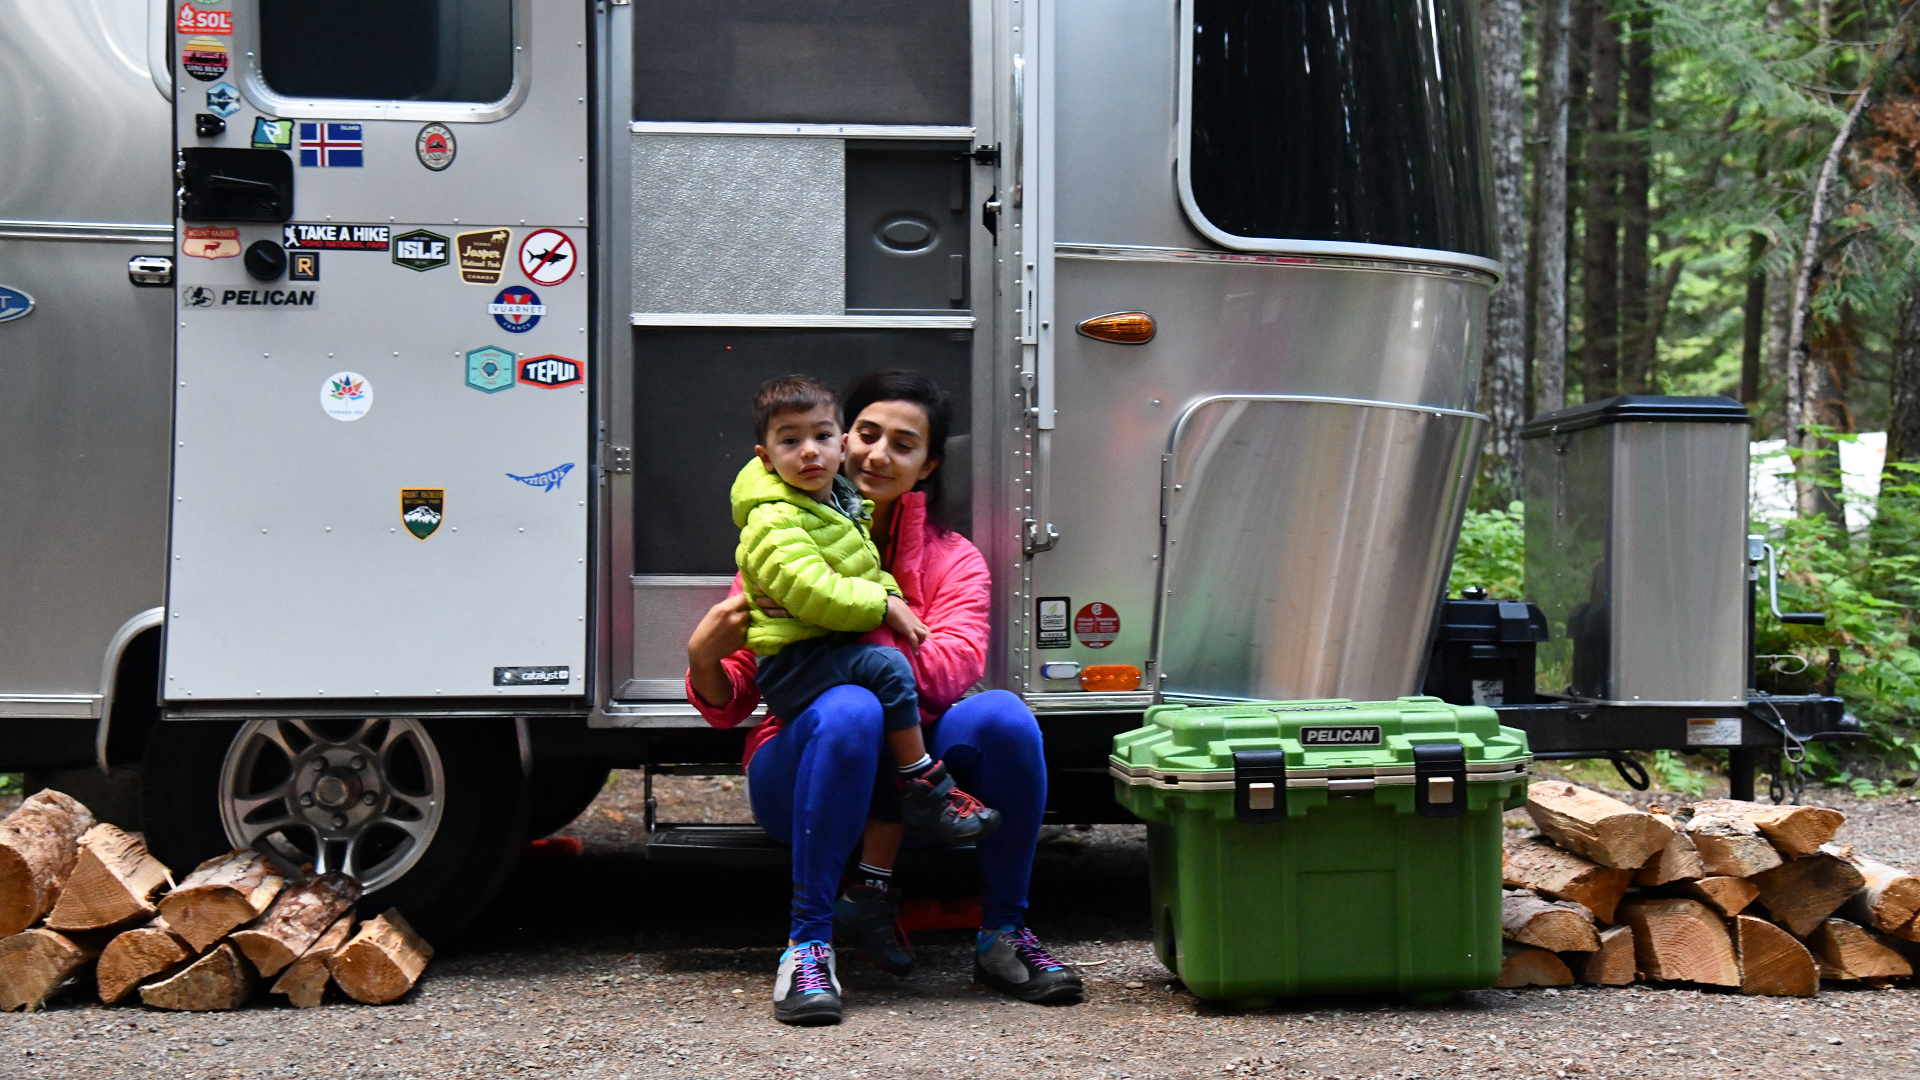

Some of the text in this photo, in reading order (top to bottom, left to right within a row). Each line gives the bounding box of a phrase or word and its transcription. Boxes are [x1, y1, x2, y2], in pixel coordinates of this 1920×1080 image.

[196, 12, 231, 28] SOL
[298, 225, 389, 242] TAKE A HIKE
[397, 240, 446, 260] ISLE
[461, 245, 501, 260] Jasper
[297, 257, 314, 276] R
[221, 289, 316, 306] PELICAN
[492, 305, 542, 314] VUARNET
[526, 359, 575, 384] TEPUI
[521, 671, 559, 682] catalyst
[1306, 729, 1375, 742] PELICAN
